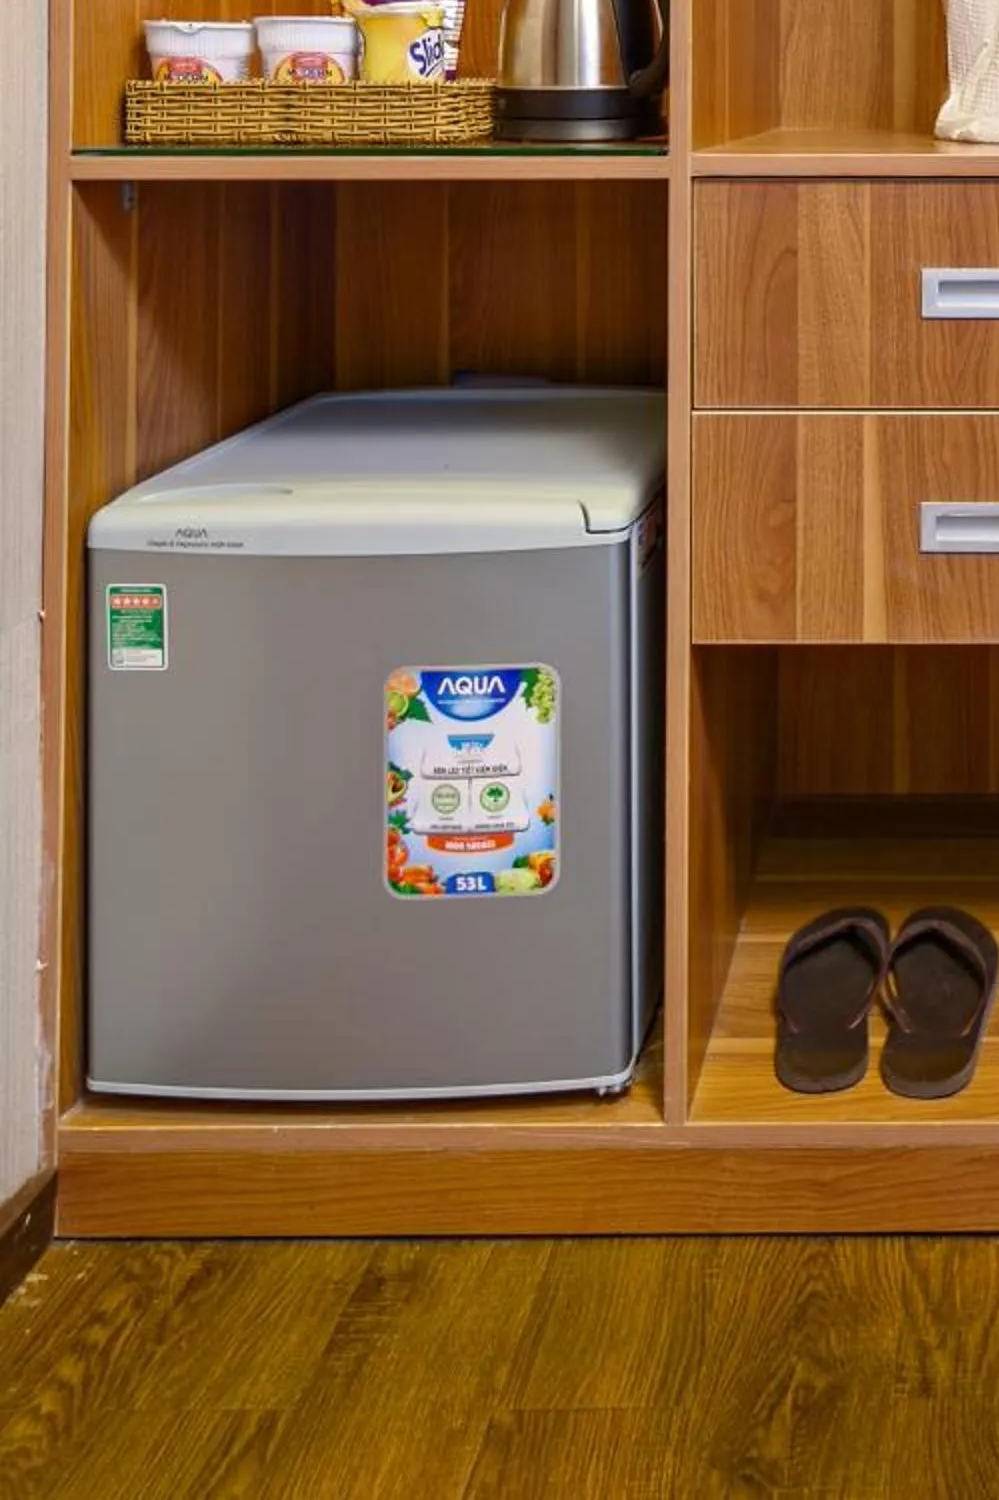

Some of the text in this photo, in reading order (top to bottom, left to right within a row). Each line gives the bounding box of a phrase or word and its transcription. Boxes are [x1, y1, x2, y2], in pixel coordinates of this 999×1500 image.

[175, 527, 208, 538] AQUA
[437, 675, 506, 695] AQUA
[455, 875, 487, 892] 53L
